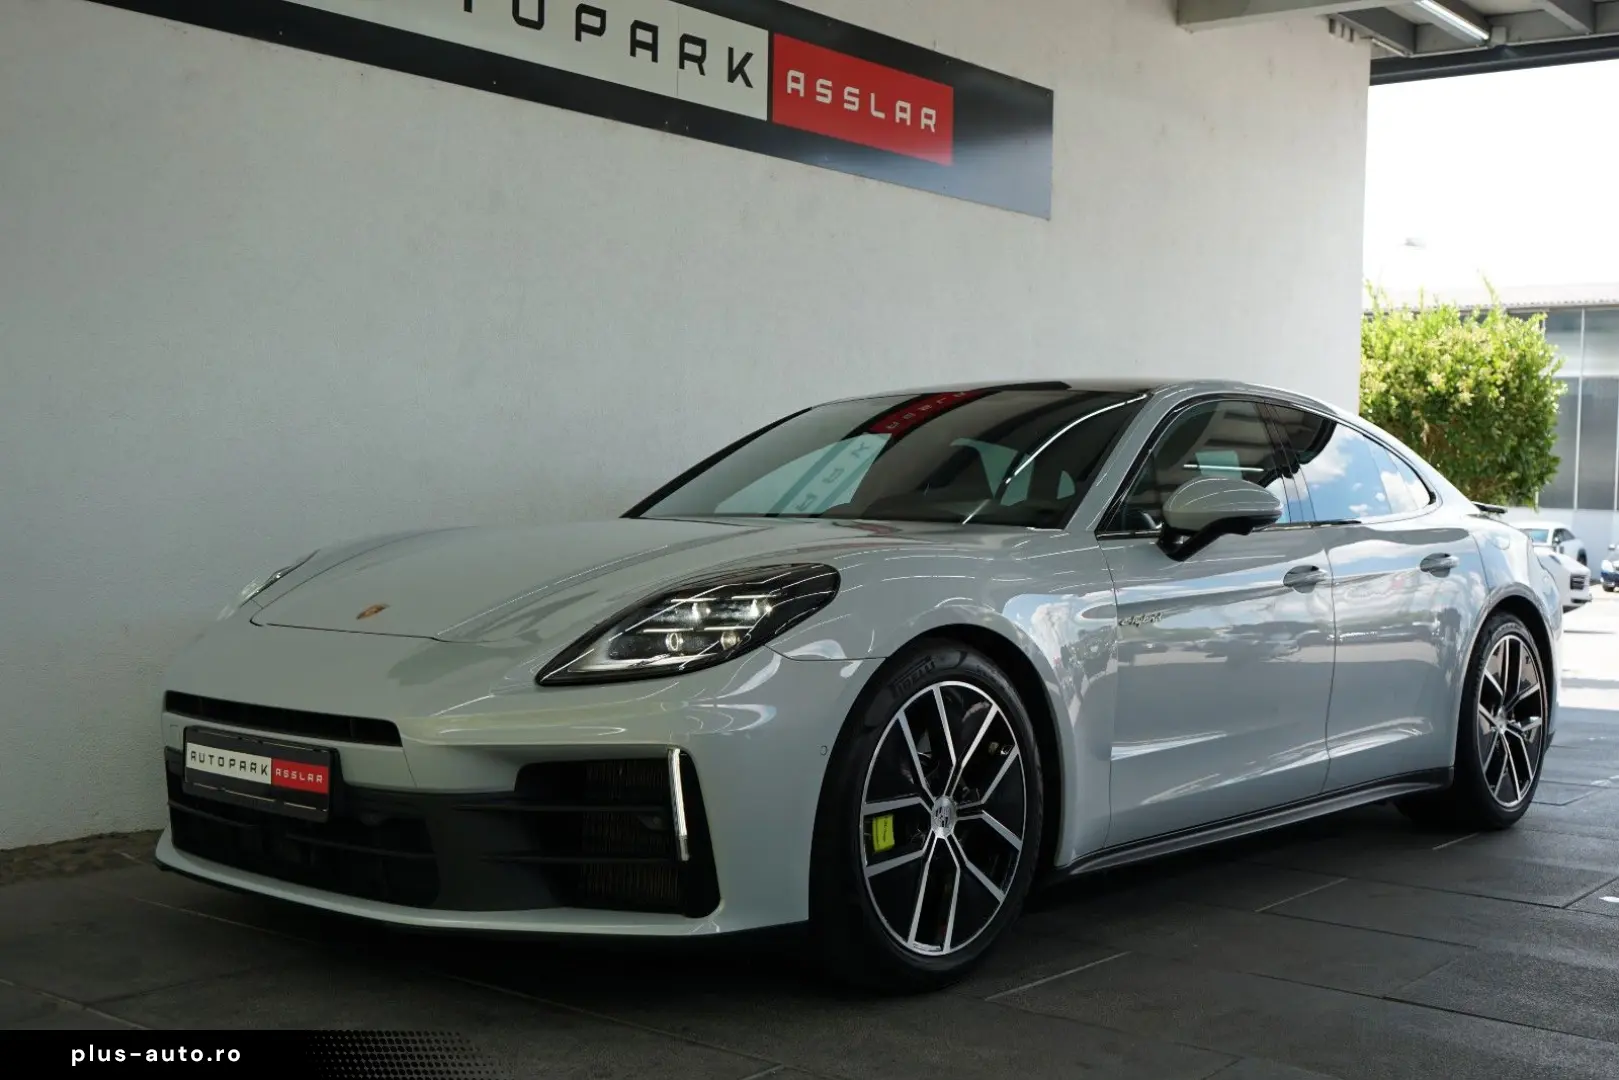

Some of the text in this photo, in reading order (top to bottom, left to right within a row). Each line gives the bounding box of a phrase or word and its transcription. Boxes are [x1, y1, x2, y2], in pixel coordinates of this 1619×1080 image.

[786, 69, 937, 133] ASSLAR
[190, 750, 324, 784] AUTOPARK ASSLAR
